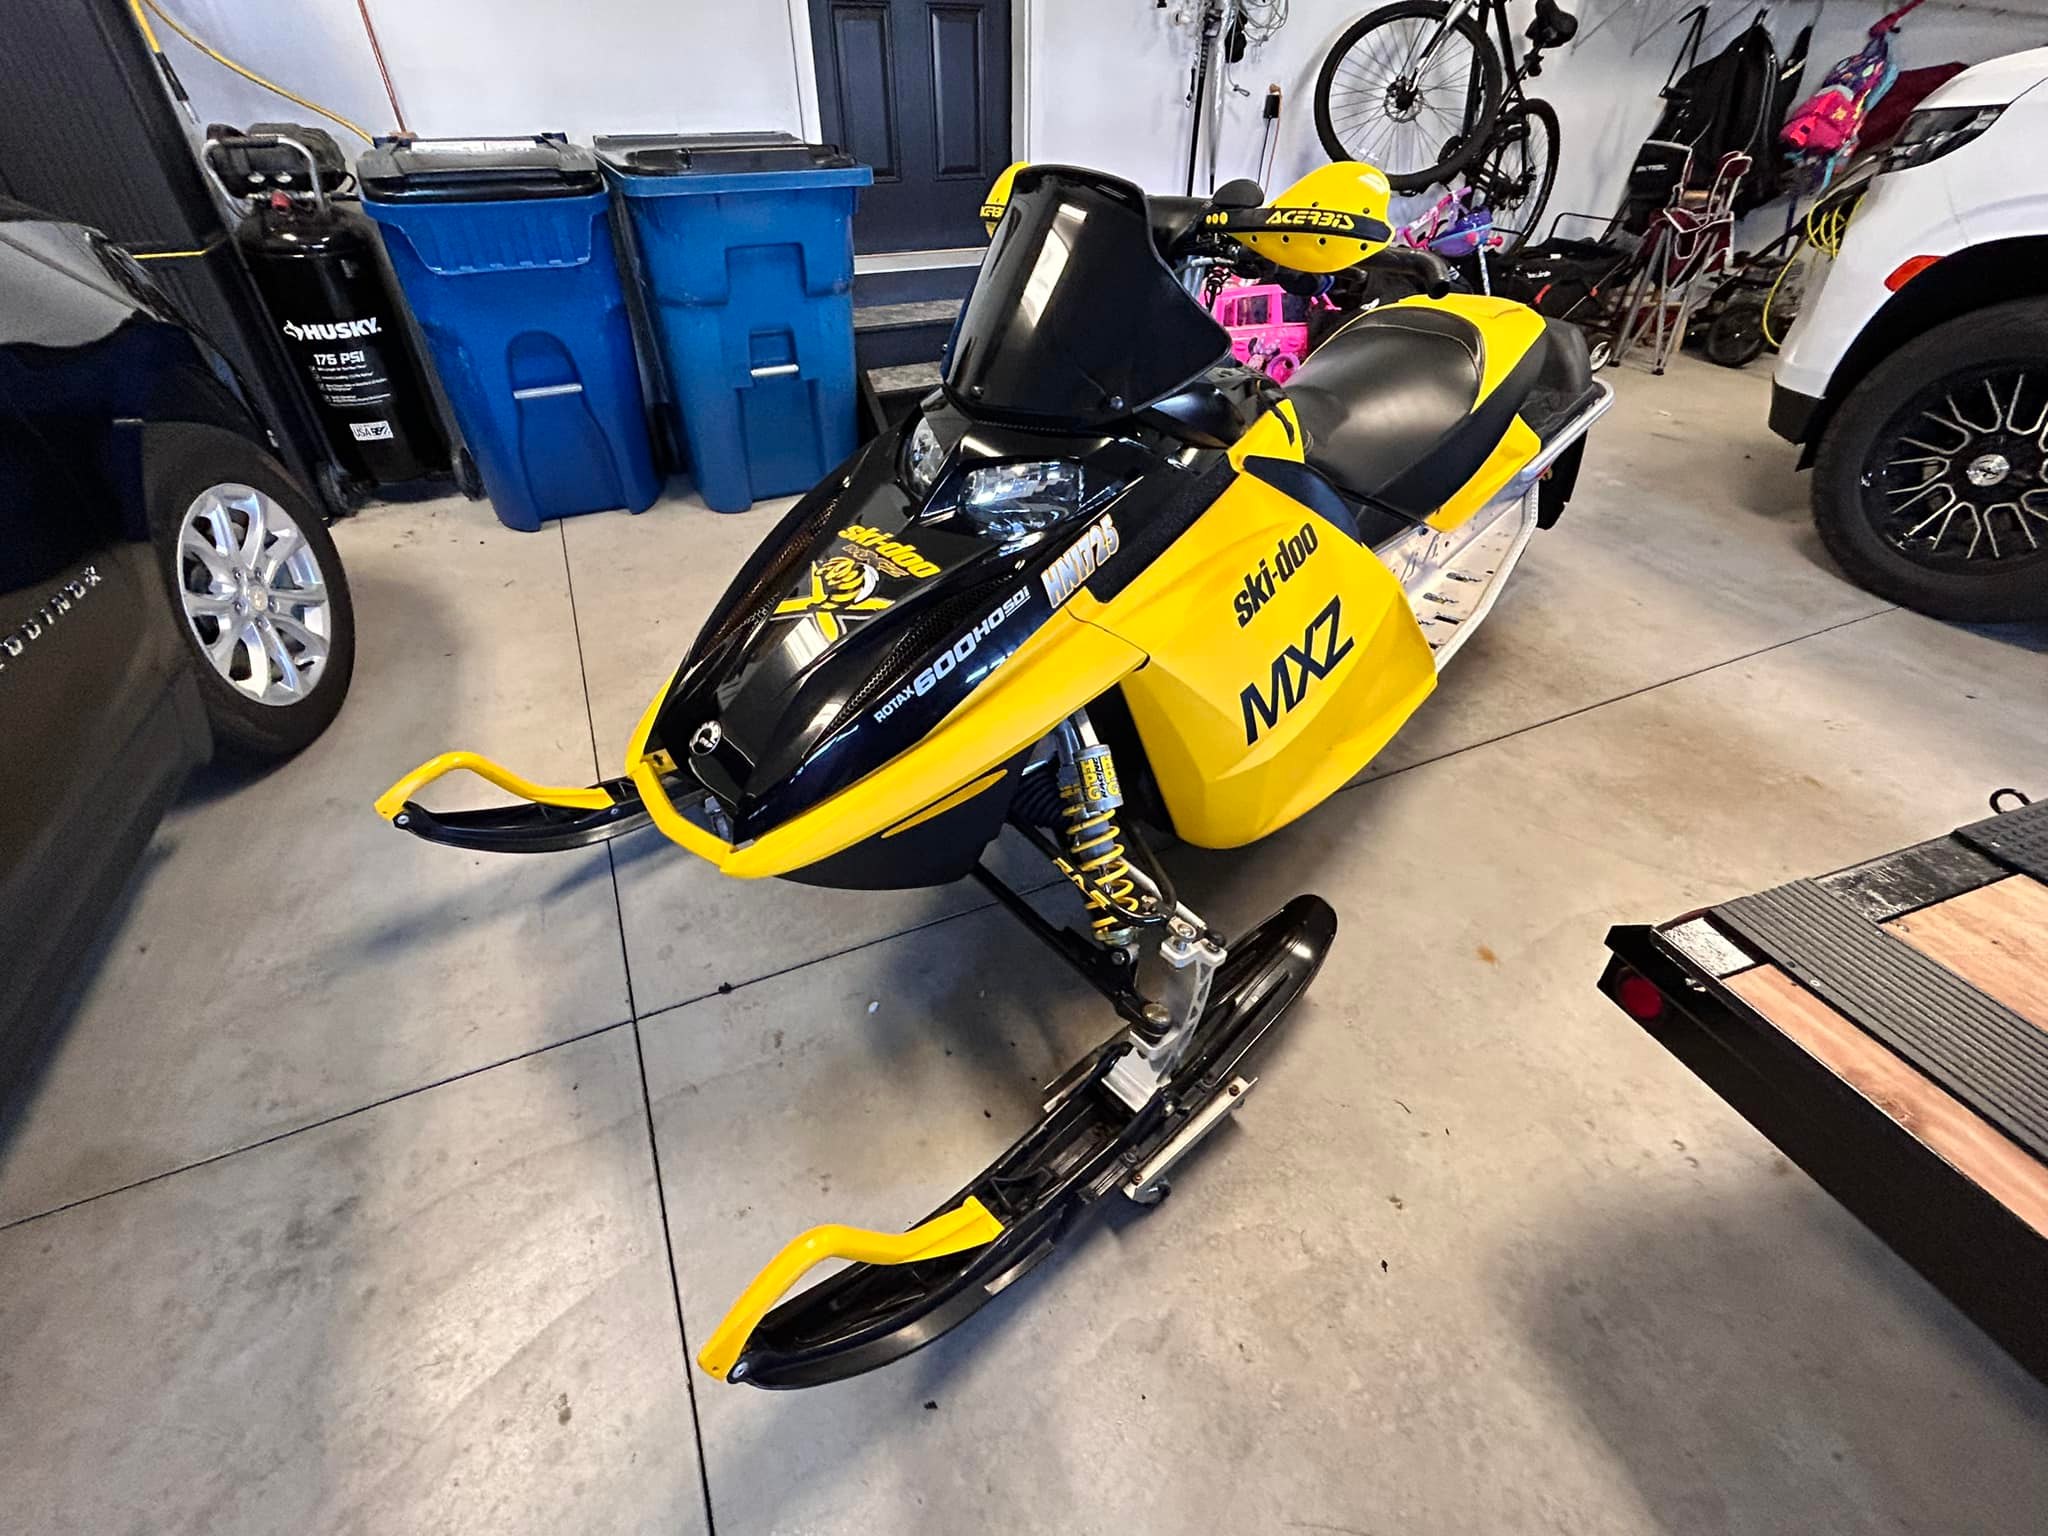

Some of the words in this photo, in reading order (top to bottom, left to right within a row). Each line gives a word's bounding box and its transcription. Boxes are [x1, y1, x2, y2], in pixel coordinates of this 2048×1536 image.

[313, 353, 338, 365] 175
[340, 350, 365, 364] PSI
[354, 427, 372, 438] USA
[1233, 522, 1319, 629] ski-doo
[0, 565, 101, 669] QUINOX
[873, 685, 916, 723] ROTAX
[1239, 594, 1355, 747] MXZ
